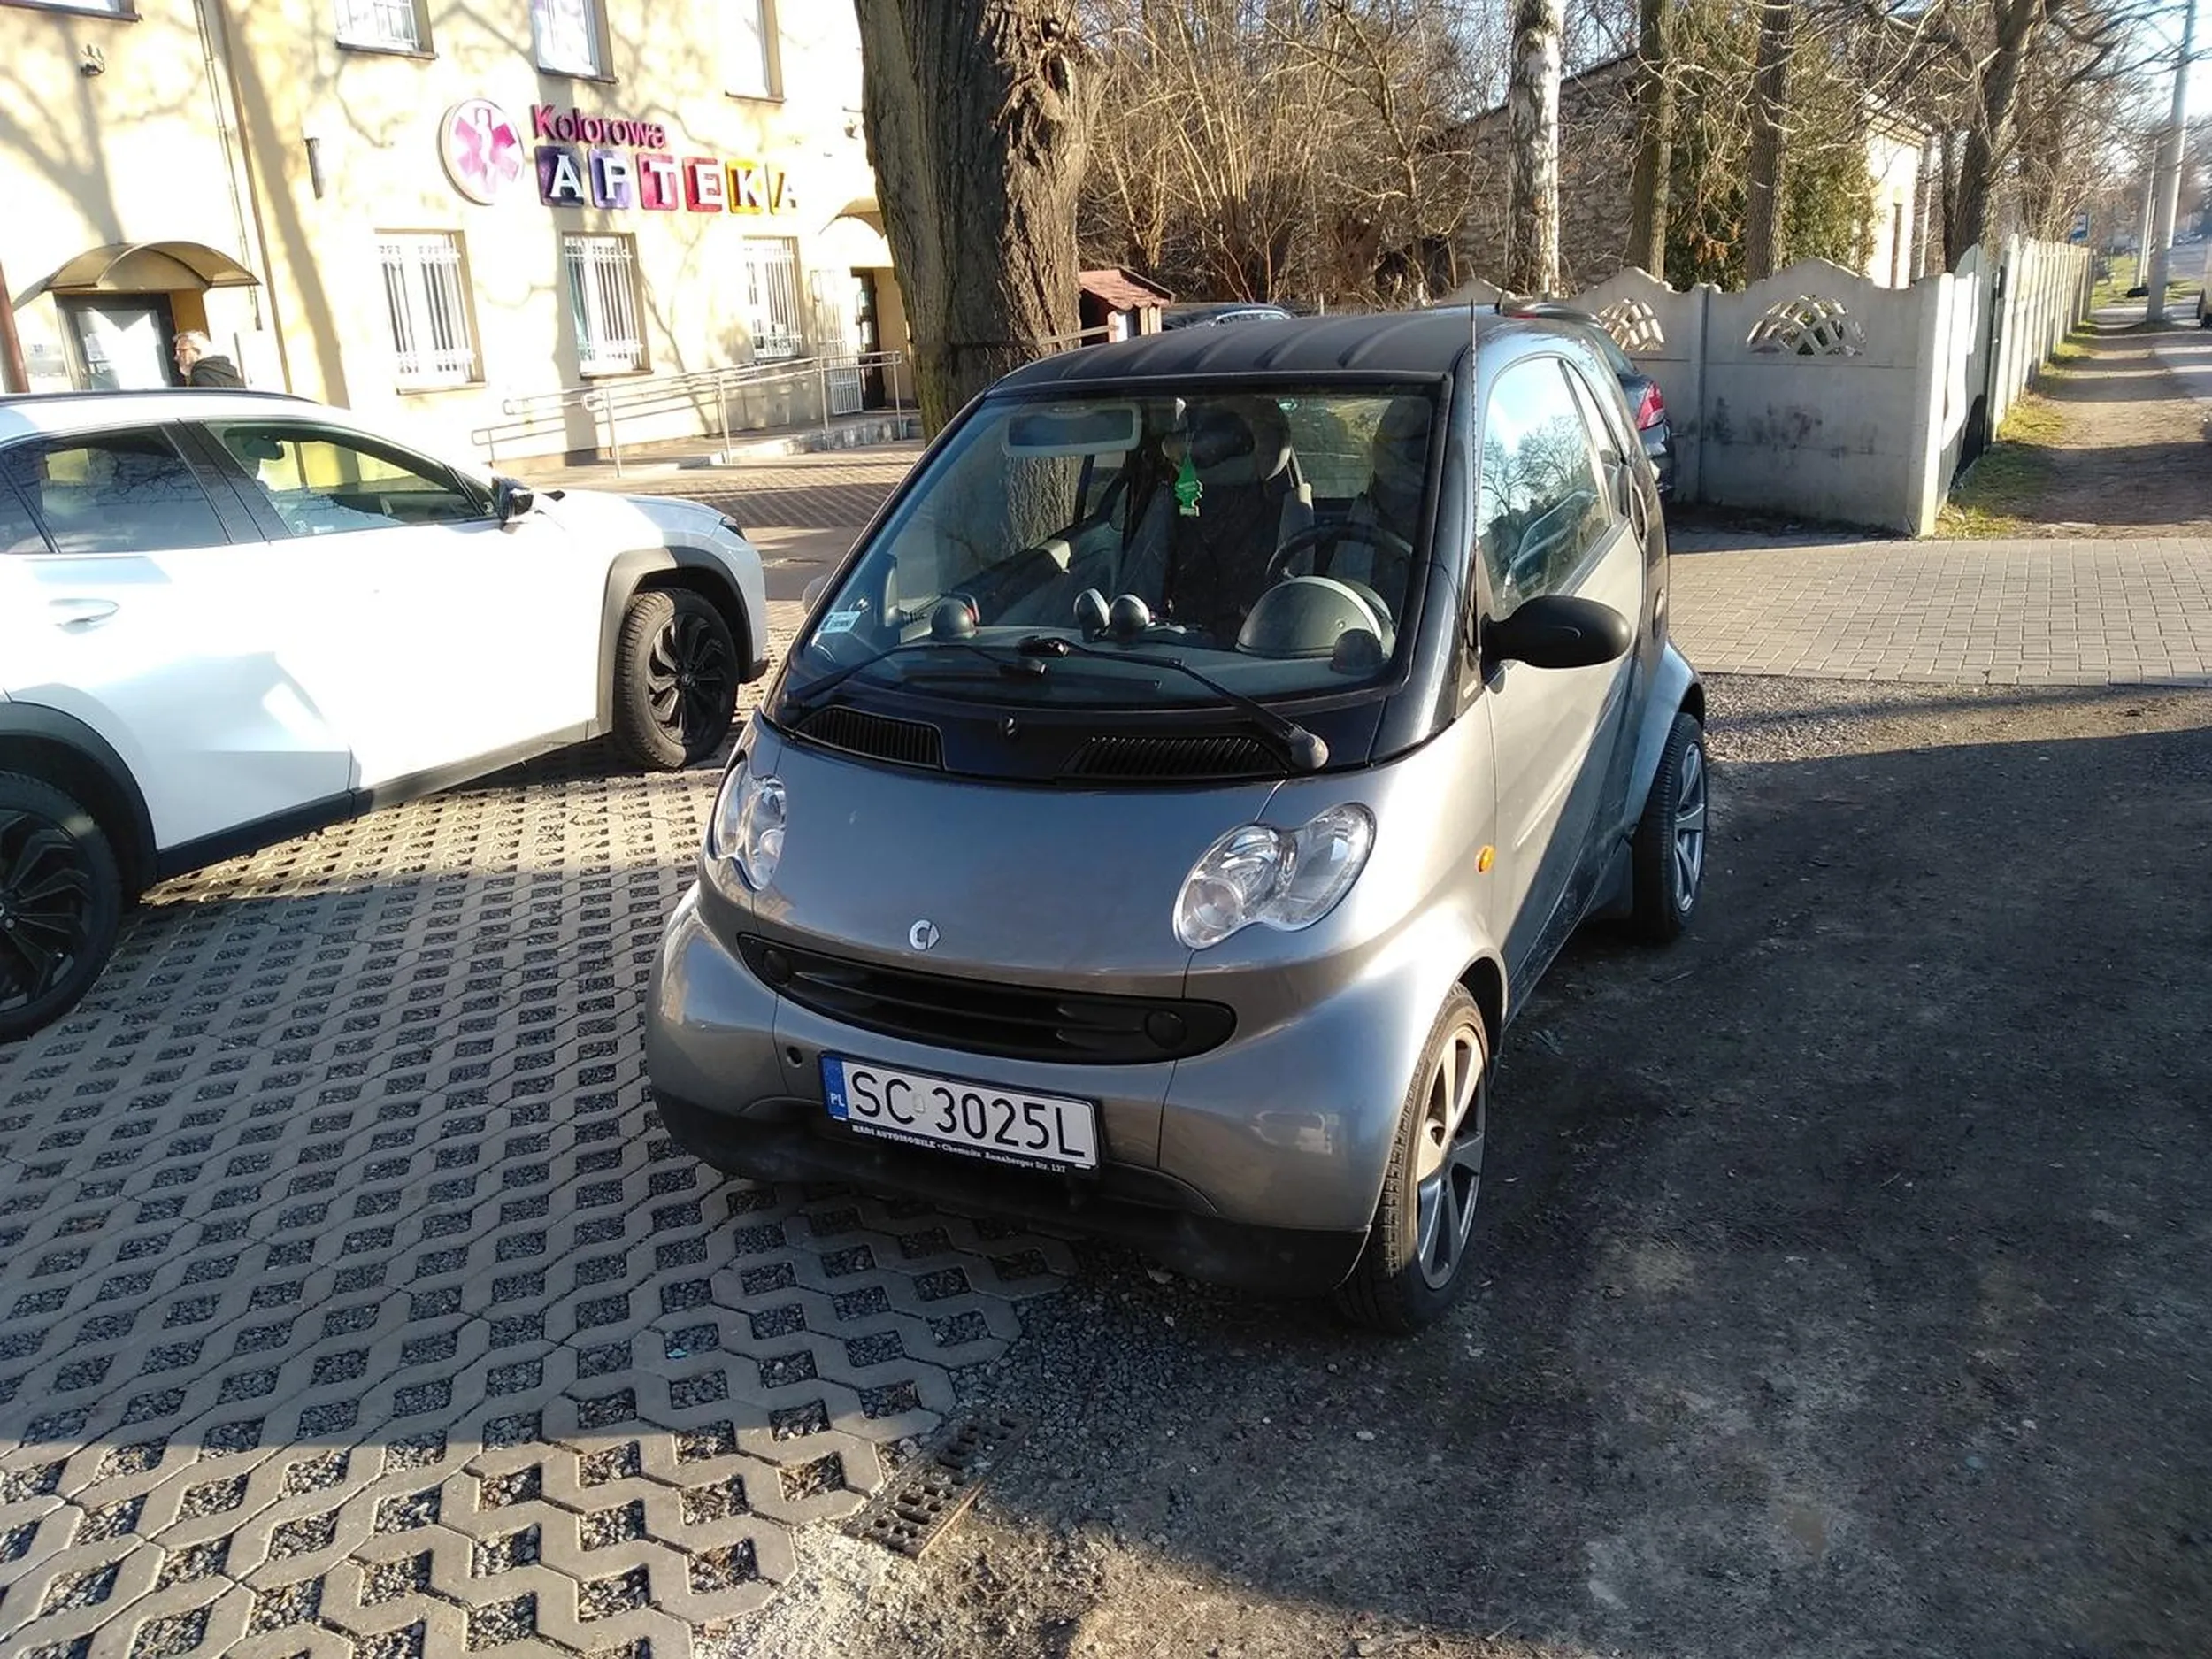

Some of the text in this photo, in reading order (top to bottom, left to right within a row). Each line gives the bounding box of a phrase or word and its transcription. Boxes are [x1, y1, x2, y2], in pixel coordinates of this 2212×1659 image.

[530, 104, 667, 149] Kolorowa
[536, 148, 798, 214] APTEKA
[829, 1092, 845, 1107] PL
[851, 1071, 1086, 1158] SC 3025L
